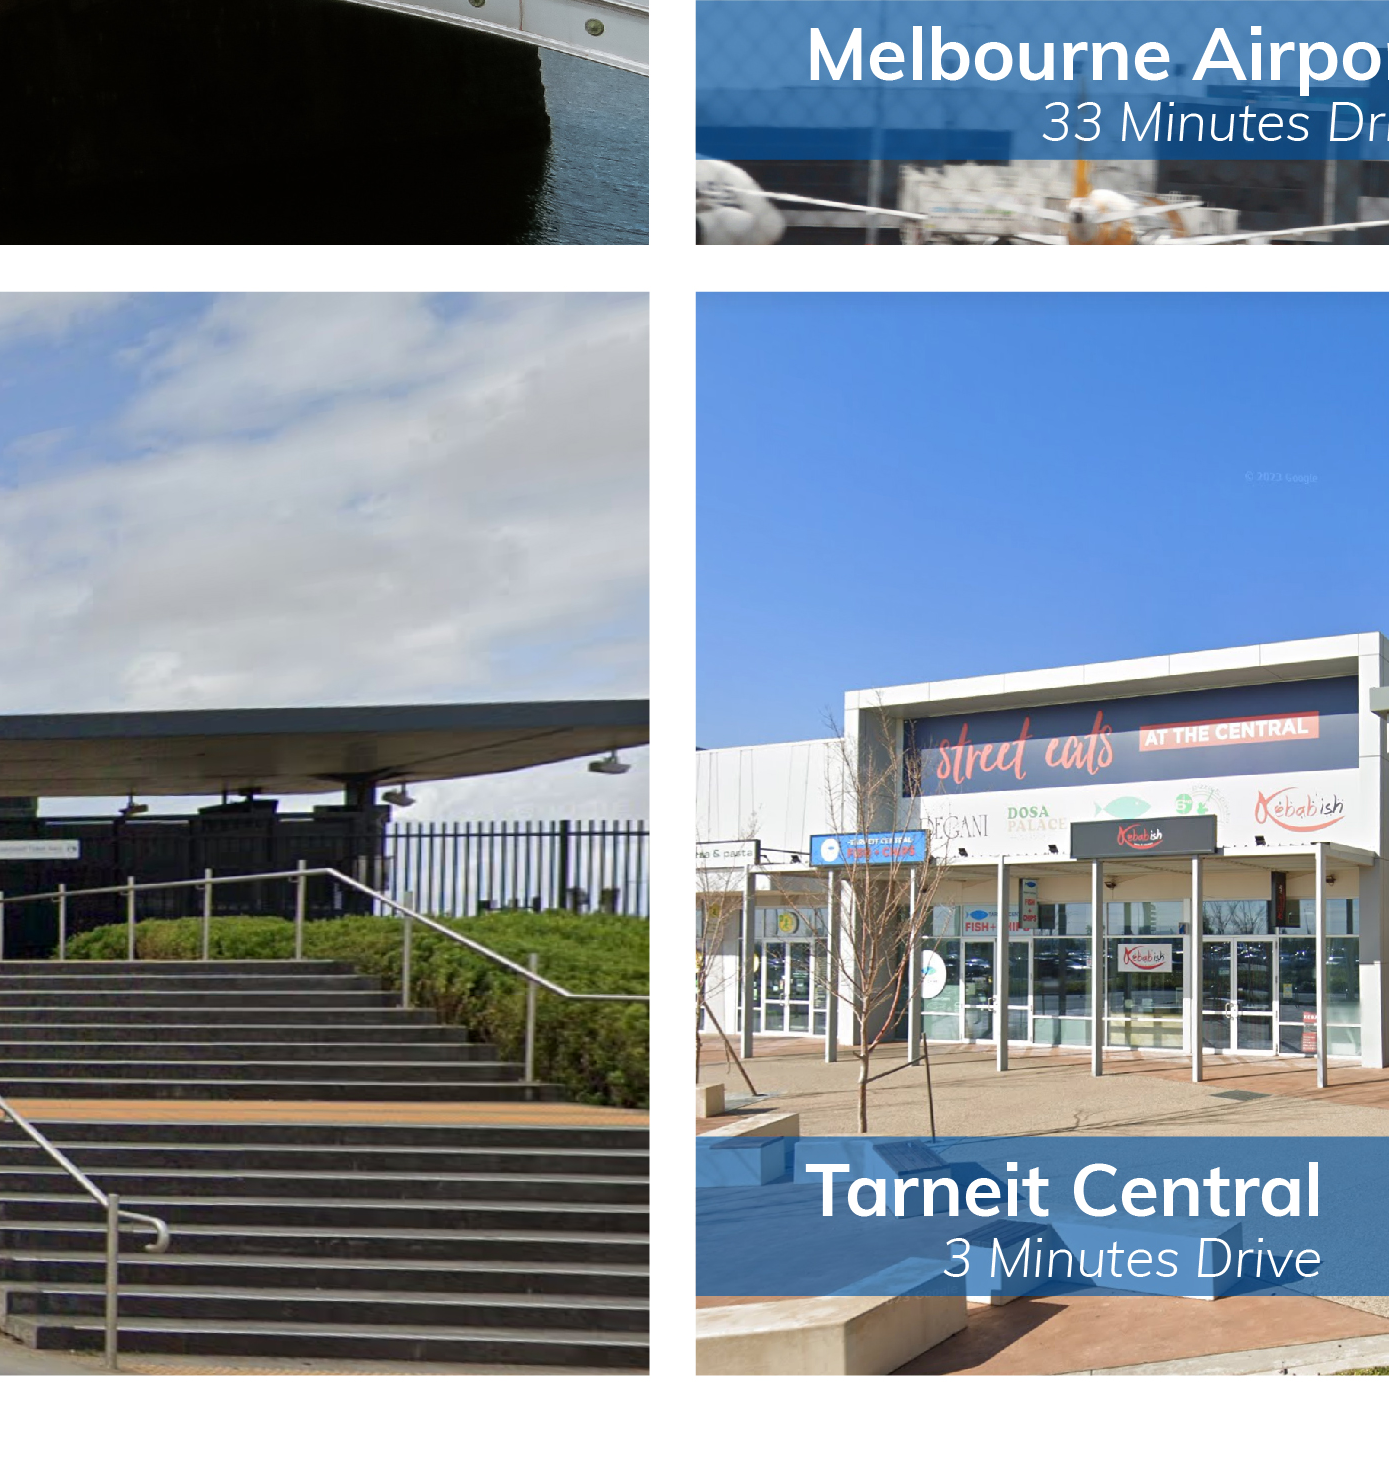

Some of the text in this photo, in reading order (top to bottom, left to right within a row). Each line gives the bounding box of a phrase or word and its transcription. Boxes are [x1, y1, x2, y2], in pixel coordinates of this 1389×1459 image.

[1145, 717, 1309, 747] AT THE CENTRAL
[937, 710, 1113, 784] street eats
[1007, 805, 1049, 820] DOSA
[1255, 788, 1345, 830] Kebabish
[1007, 818, 1068, 833] PALACE
[1117, 823, 1163, 847] Kebabish
[713, 849, 719, 858] &
[1025, 898, 1036, 906] FISH
[1022, 914, 1037, 922] CHIPS
[964, 921, 989, 932] FISH
[1123, 945, 1166, 970] Kebabish
